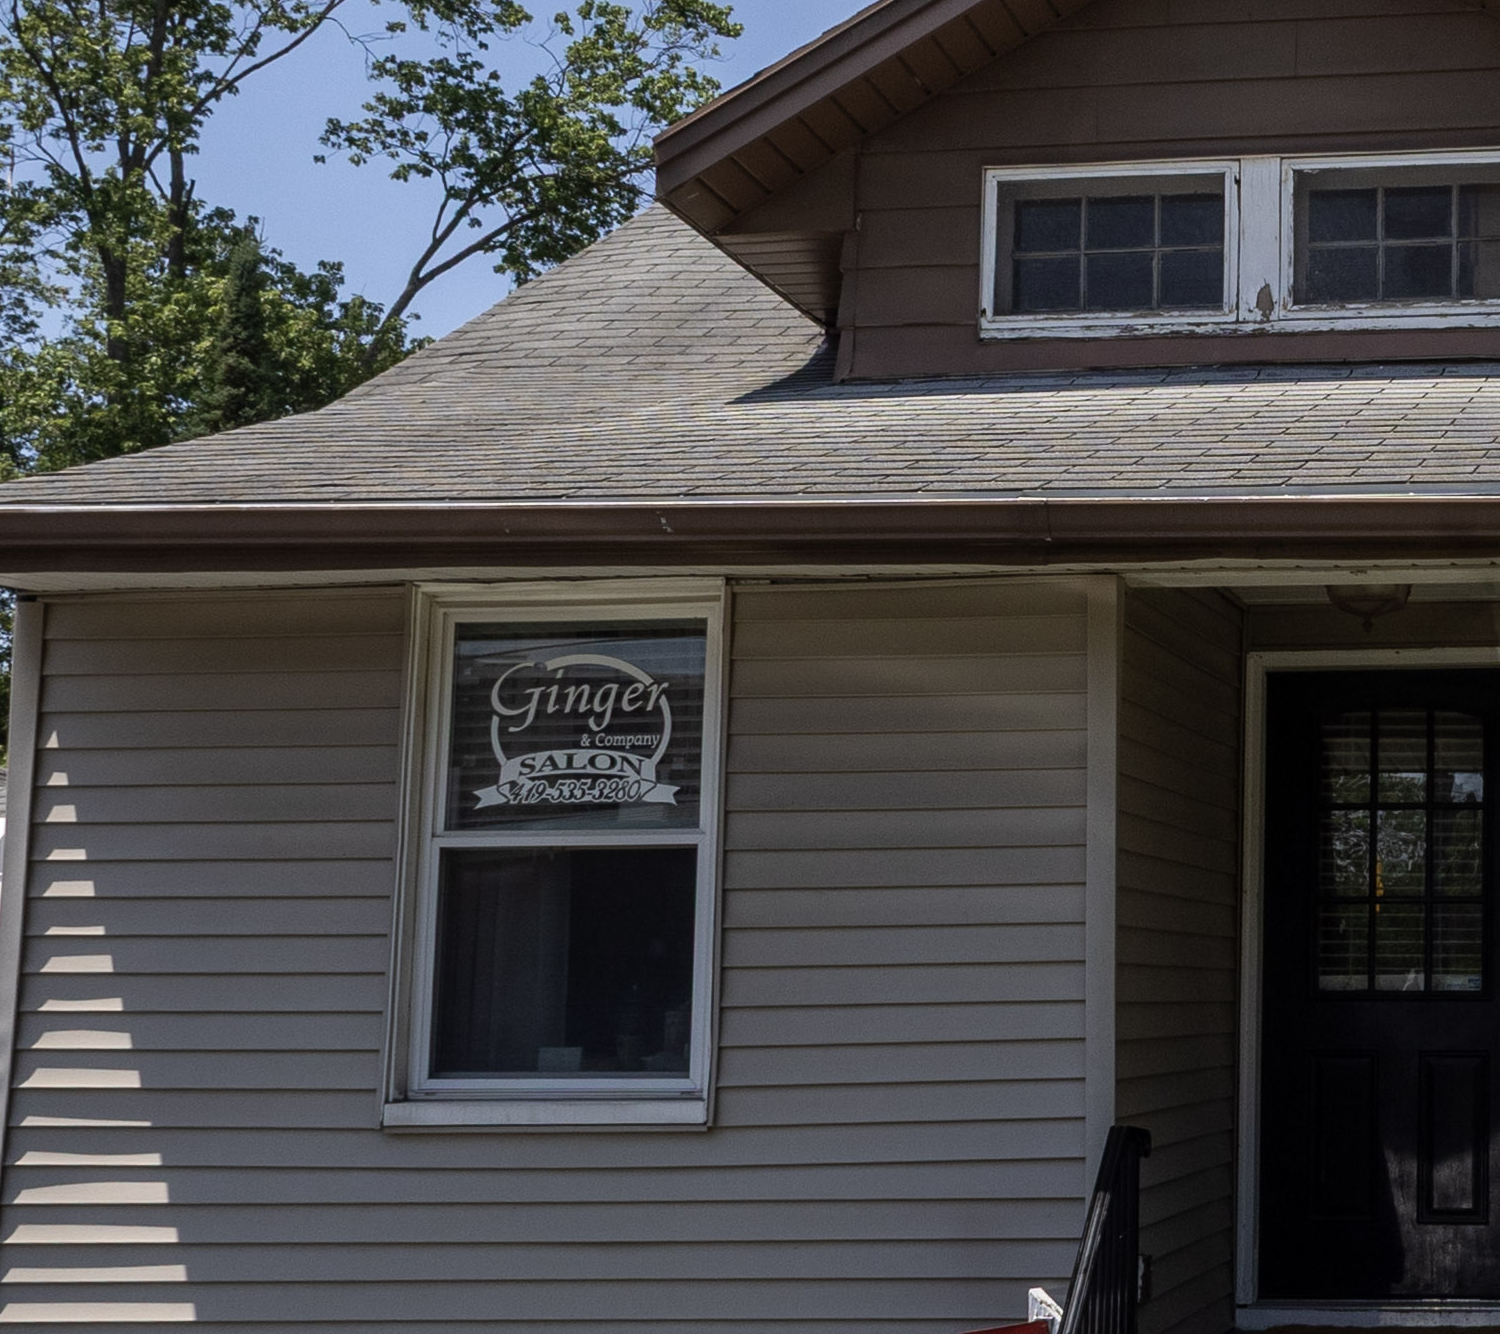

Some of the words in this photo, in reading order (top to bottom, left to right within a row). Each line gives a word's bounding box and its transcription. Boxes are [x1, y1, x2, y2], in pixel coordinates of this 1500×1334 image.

[491, 662, 668, 732] Ginger
[580, 733, 591, 747] &
[595, 733, 661, 749] Company
[518, 753, 644, 777] SALON
[509, 778, 642, 804] 419-535-3280
